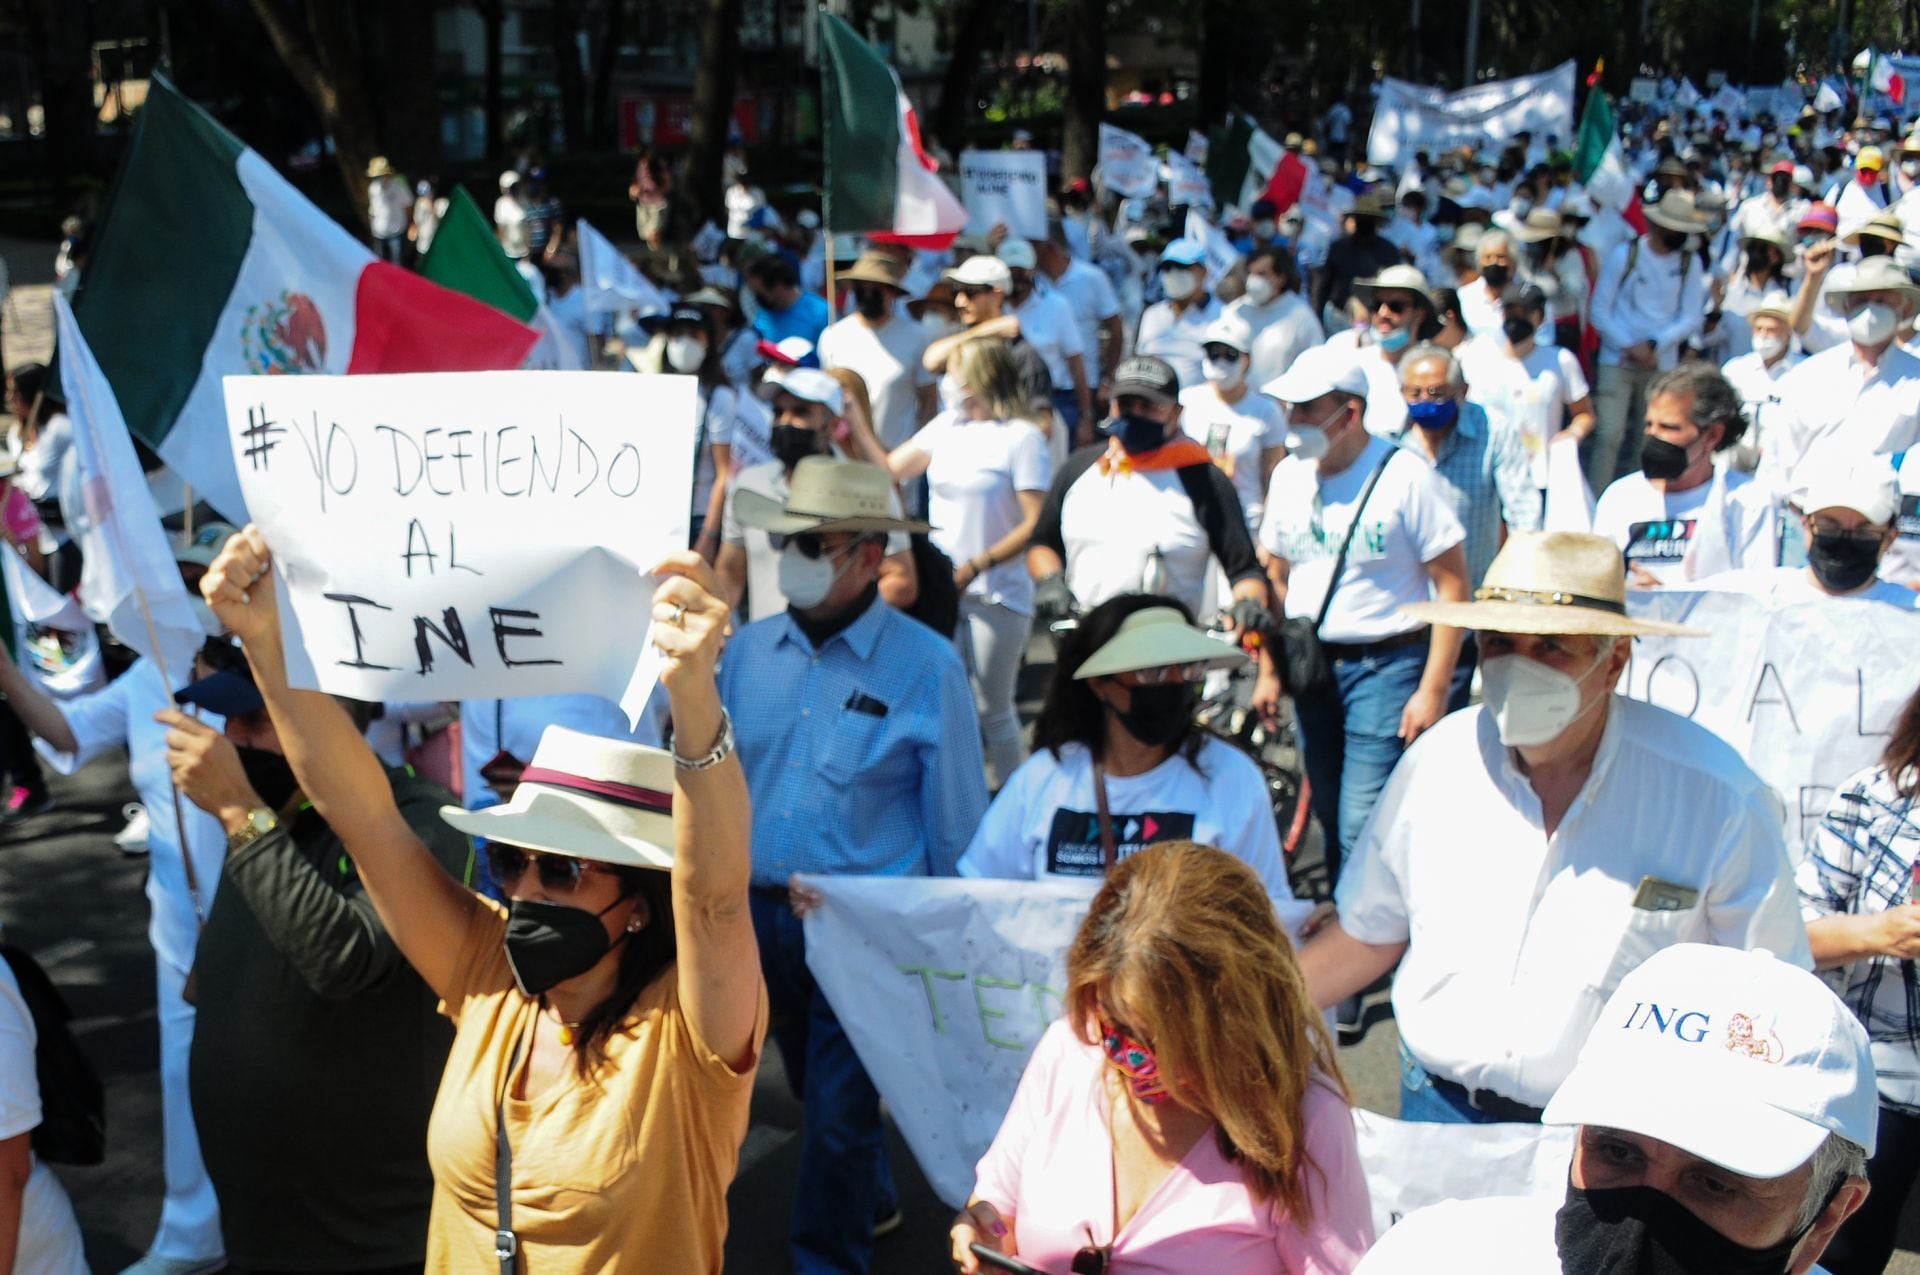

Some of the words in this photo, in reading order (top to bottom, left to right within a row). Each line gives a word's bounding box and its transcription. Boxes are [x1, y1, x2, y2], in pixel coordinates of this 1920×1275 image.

[375, 413, 641, 498] DEFIENDO
[400, 517, 484, 577] AL
[323, 592, 564, 676] INE
[1622, 1002, 1711, 1043] ING
